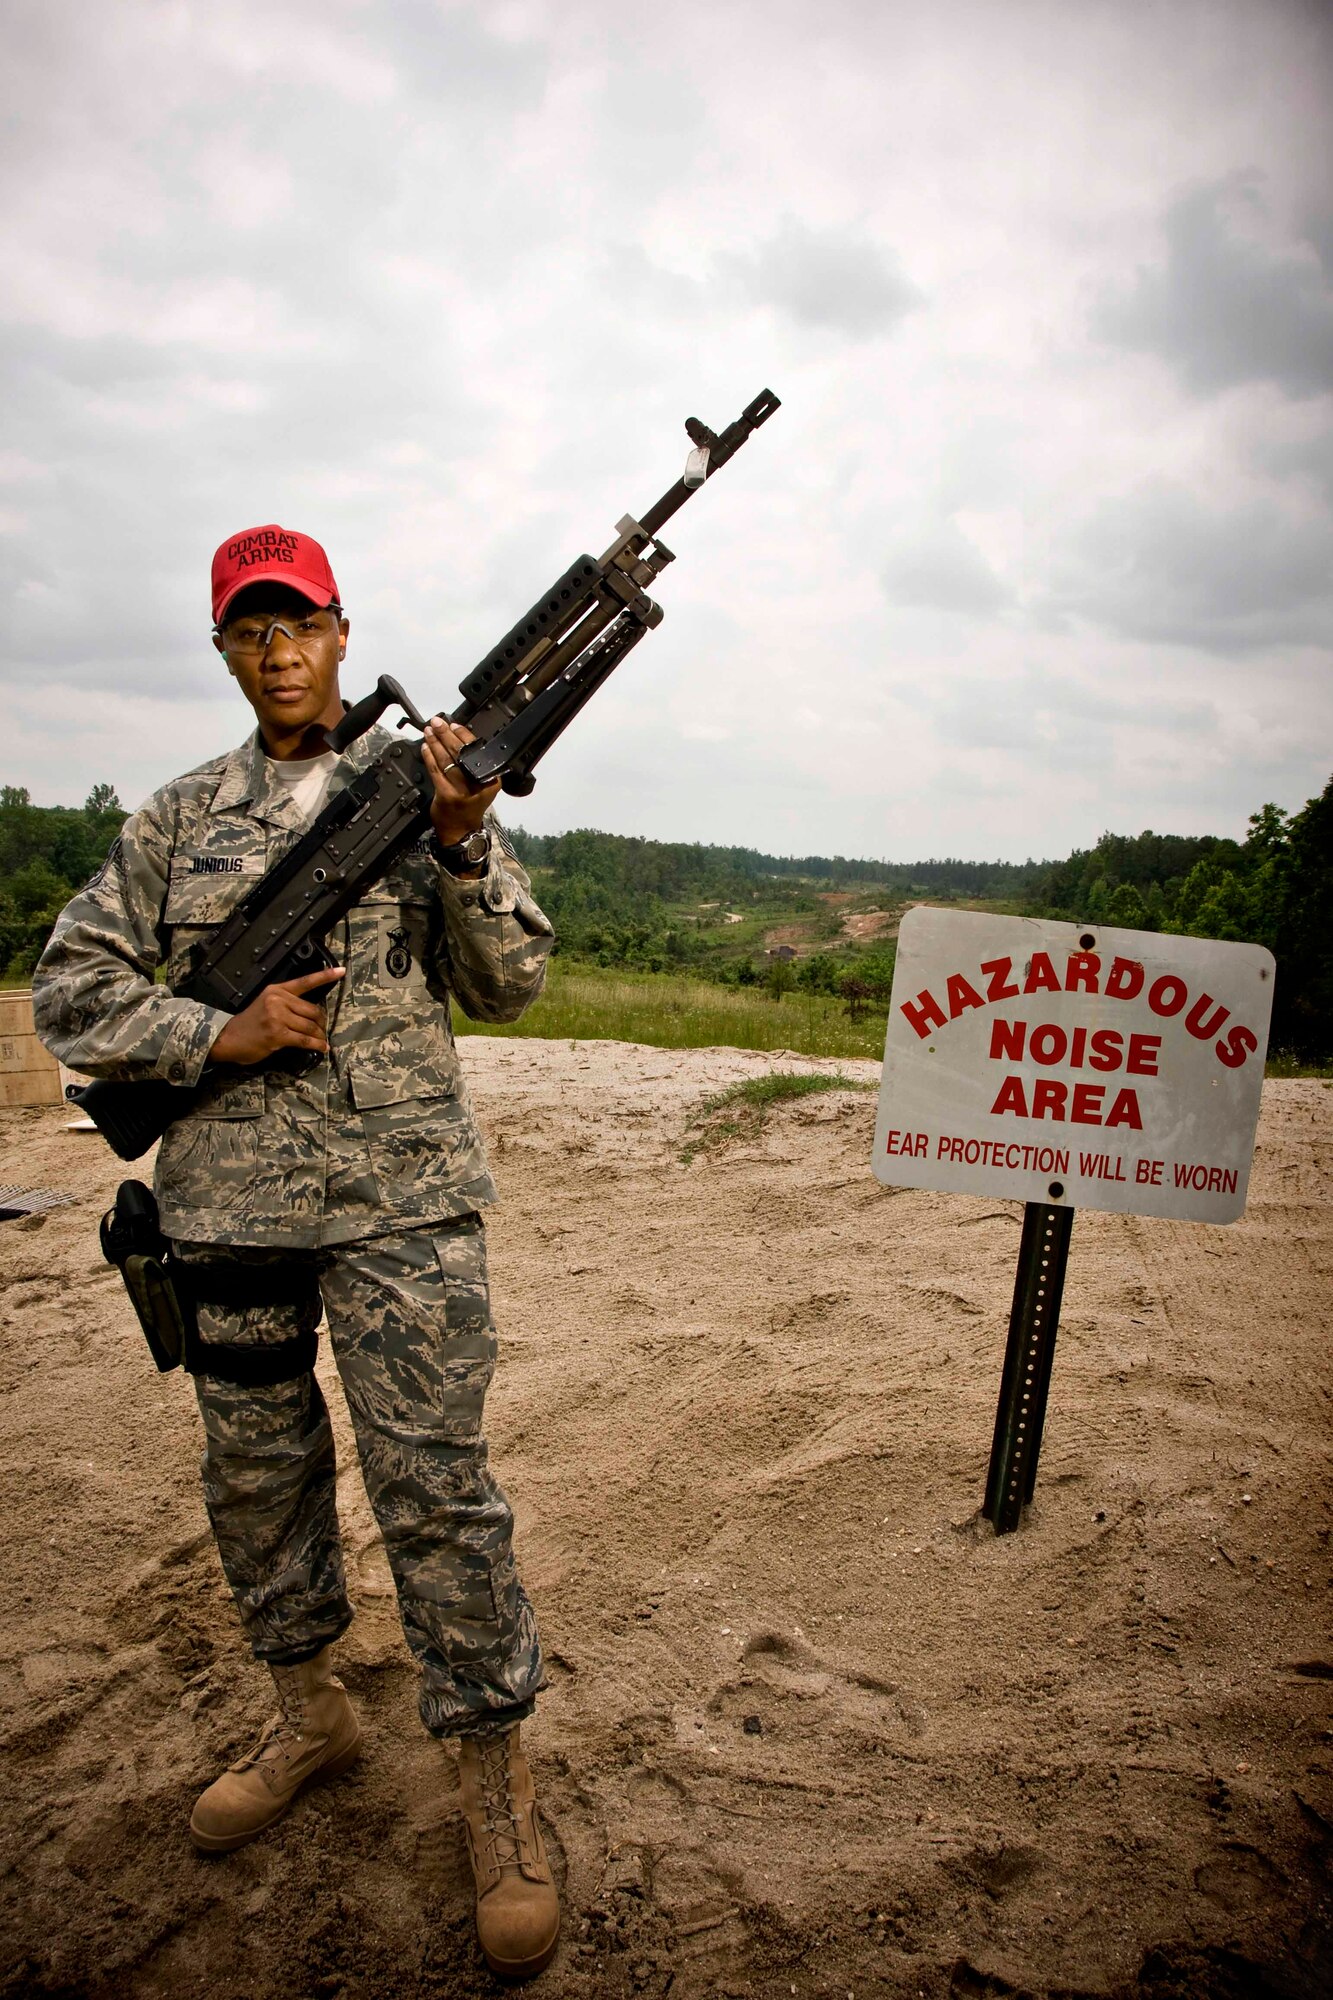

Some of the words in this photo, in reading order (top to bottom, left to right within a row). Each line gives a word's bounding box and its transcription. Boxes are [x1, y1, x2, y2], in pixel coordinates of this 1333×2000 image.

[228, 531, 298, 560] COMBAT
[237, 547, 294, 571] ARMS
[189, 857, 243, 873] JUNIOUS
[900, 949, 1258, 1069] HAZARDOUS
[989, 1019, 1162, 1076] NOISE
[991, 1076, 1143, 1131] AREA
[886, 1130, 929, 1158] EAR
[937, 1136, 1070, 1174] PROTECTION
[1079, 1152, 1127, 1182] WILL
[1135, 1159, 1165, 1186] BE
[1174, 1163, 1239, 1194] WORN
